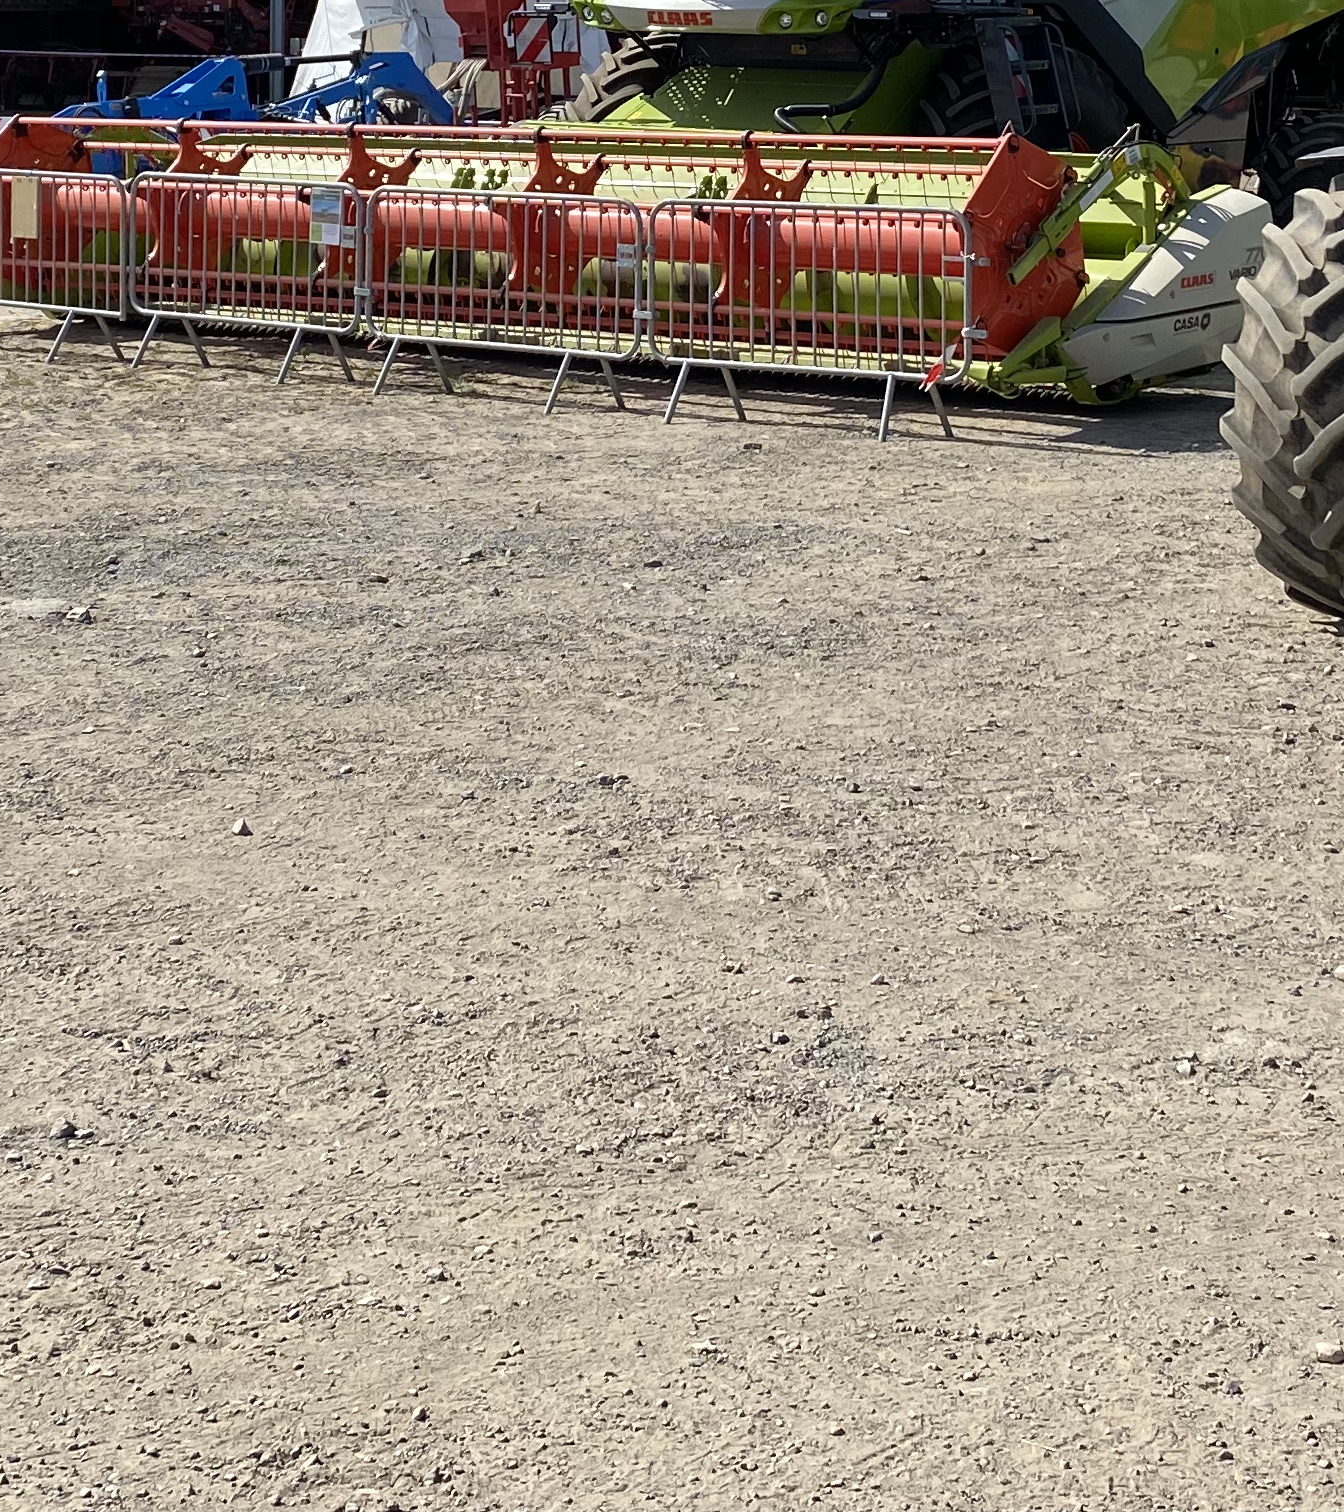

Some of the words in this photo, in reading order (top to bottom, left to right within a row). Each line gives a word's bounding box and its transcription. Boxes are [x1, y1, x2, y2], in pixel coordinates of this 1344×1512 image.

[647, 10, 713, 26] CLAAS
[1181, 273, 1214, 289] CLAAS
[1173, 316, 1199, 332] CASA
